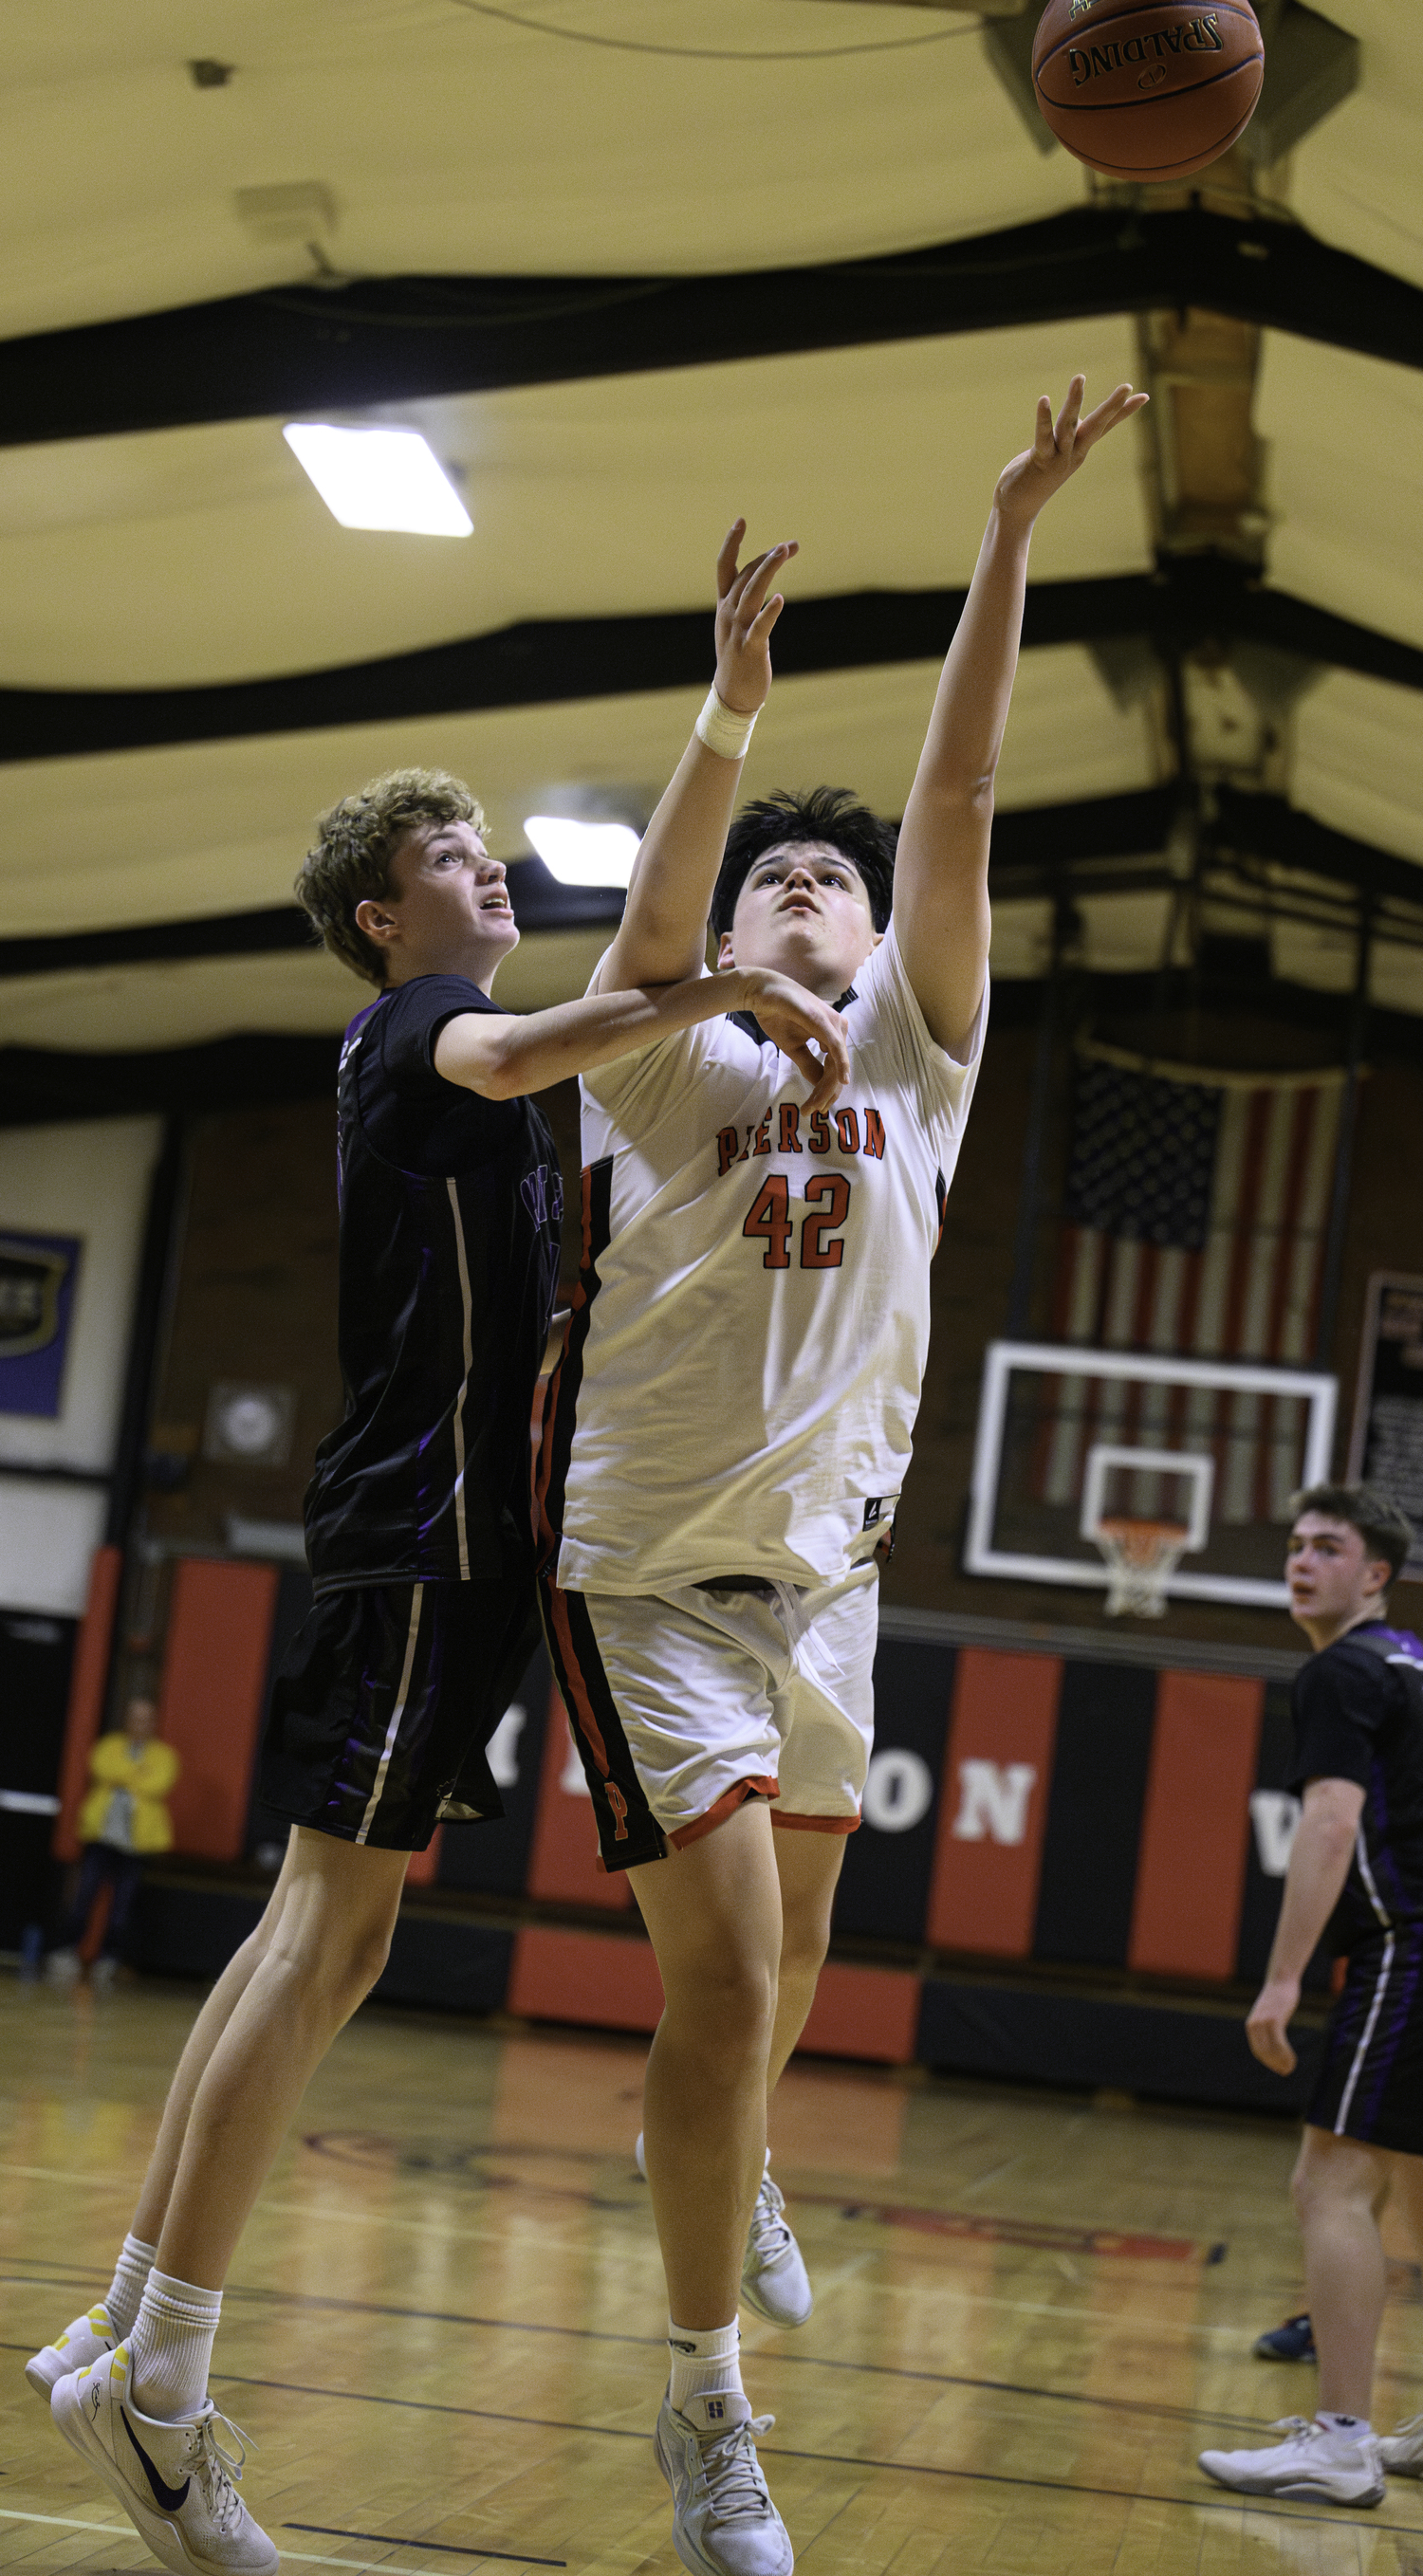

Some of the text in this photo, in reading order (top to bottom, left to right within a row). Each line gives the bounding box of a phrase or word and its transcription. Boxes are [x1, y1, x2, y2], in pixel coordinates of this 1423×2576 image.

[1068, 12, 1224, 88] SPALDING
[742, 1173, 851, 1269] 42
[604, 1774, 628, 1841] P
